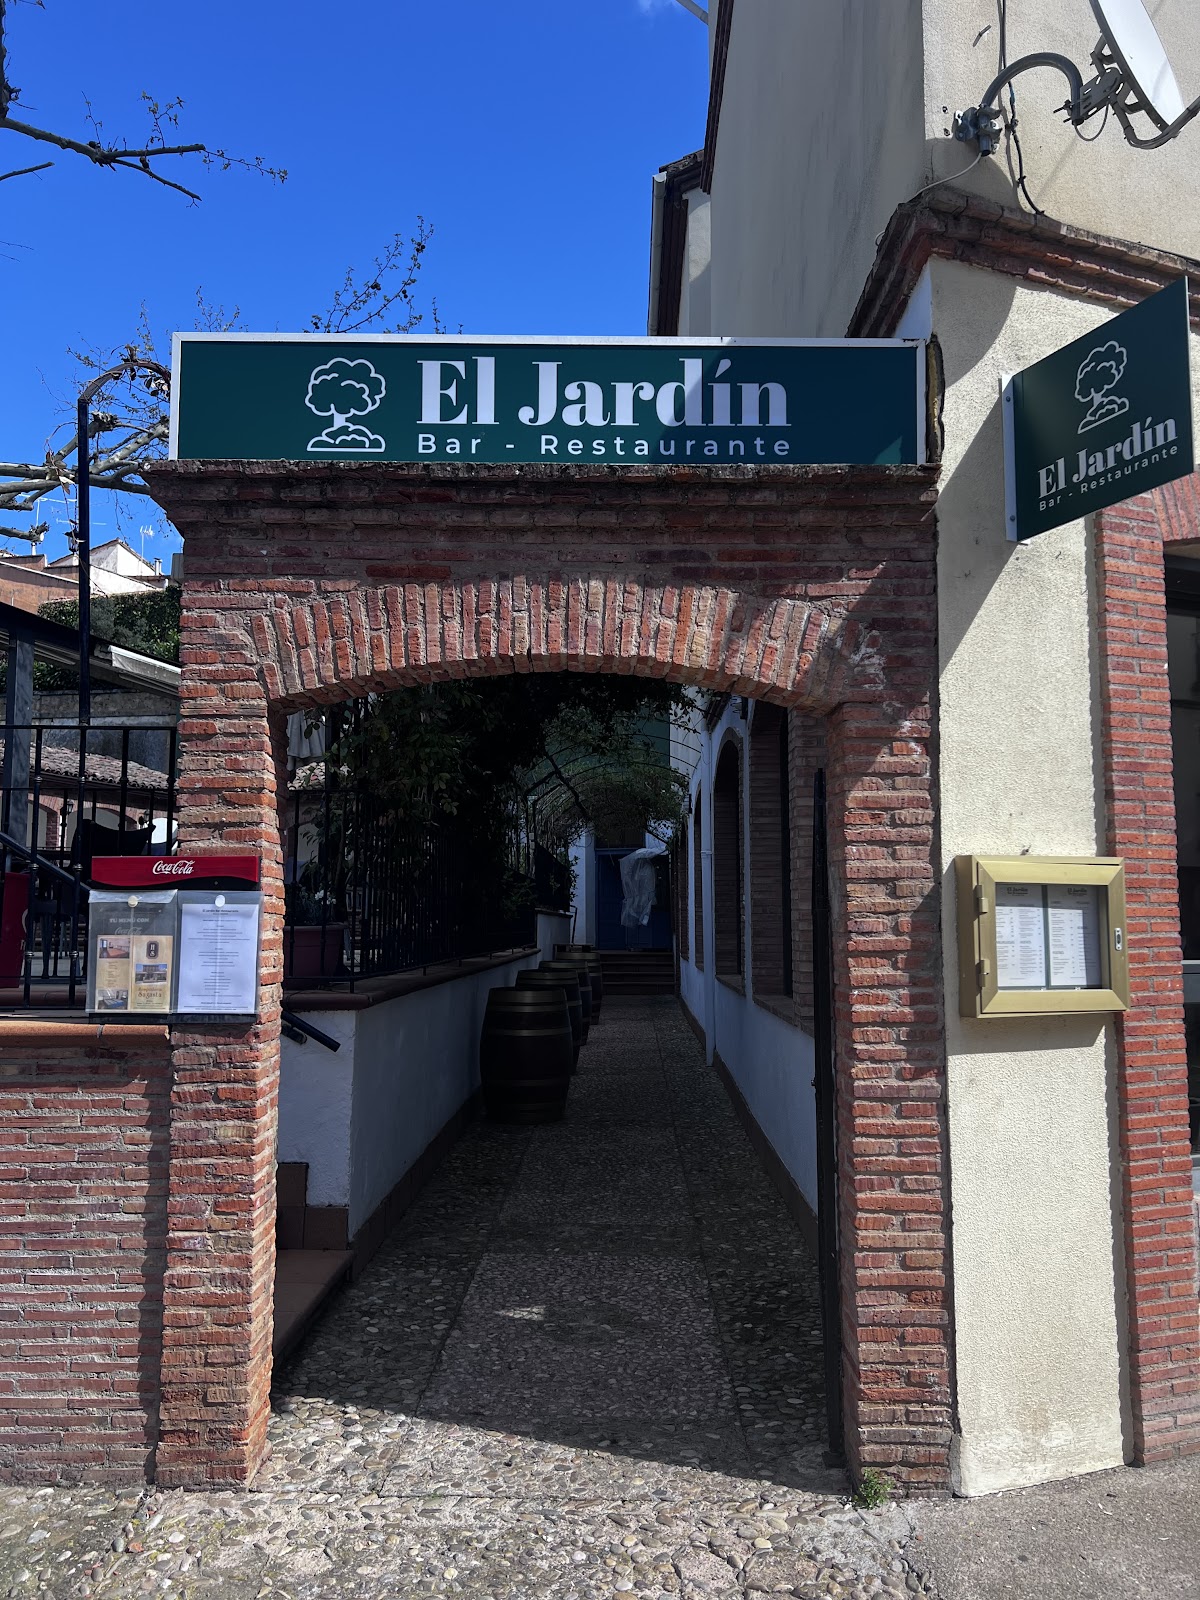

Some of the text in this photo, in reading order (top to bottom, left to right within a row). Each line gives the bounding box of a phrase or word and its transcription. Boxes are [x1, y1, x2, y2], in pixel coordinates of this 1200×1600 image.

[416, 356, 792, 427] El Jardín
[418, 433, 482, 454] Bar
[540, 435, 790, 456] Restaurante
[1037, 416, 1178, 499] El Jardín
[1039, 495, 1061, 511] Bar
[1080, 445, 1178, 494] Restaurante
[152, 859, 196, 875] Coca-Cola
